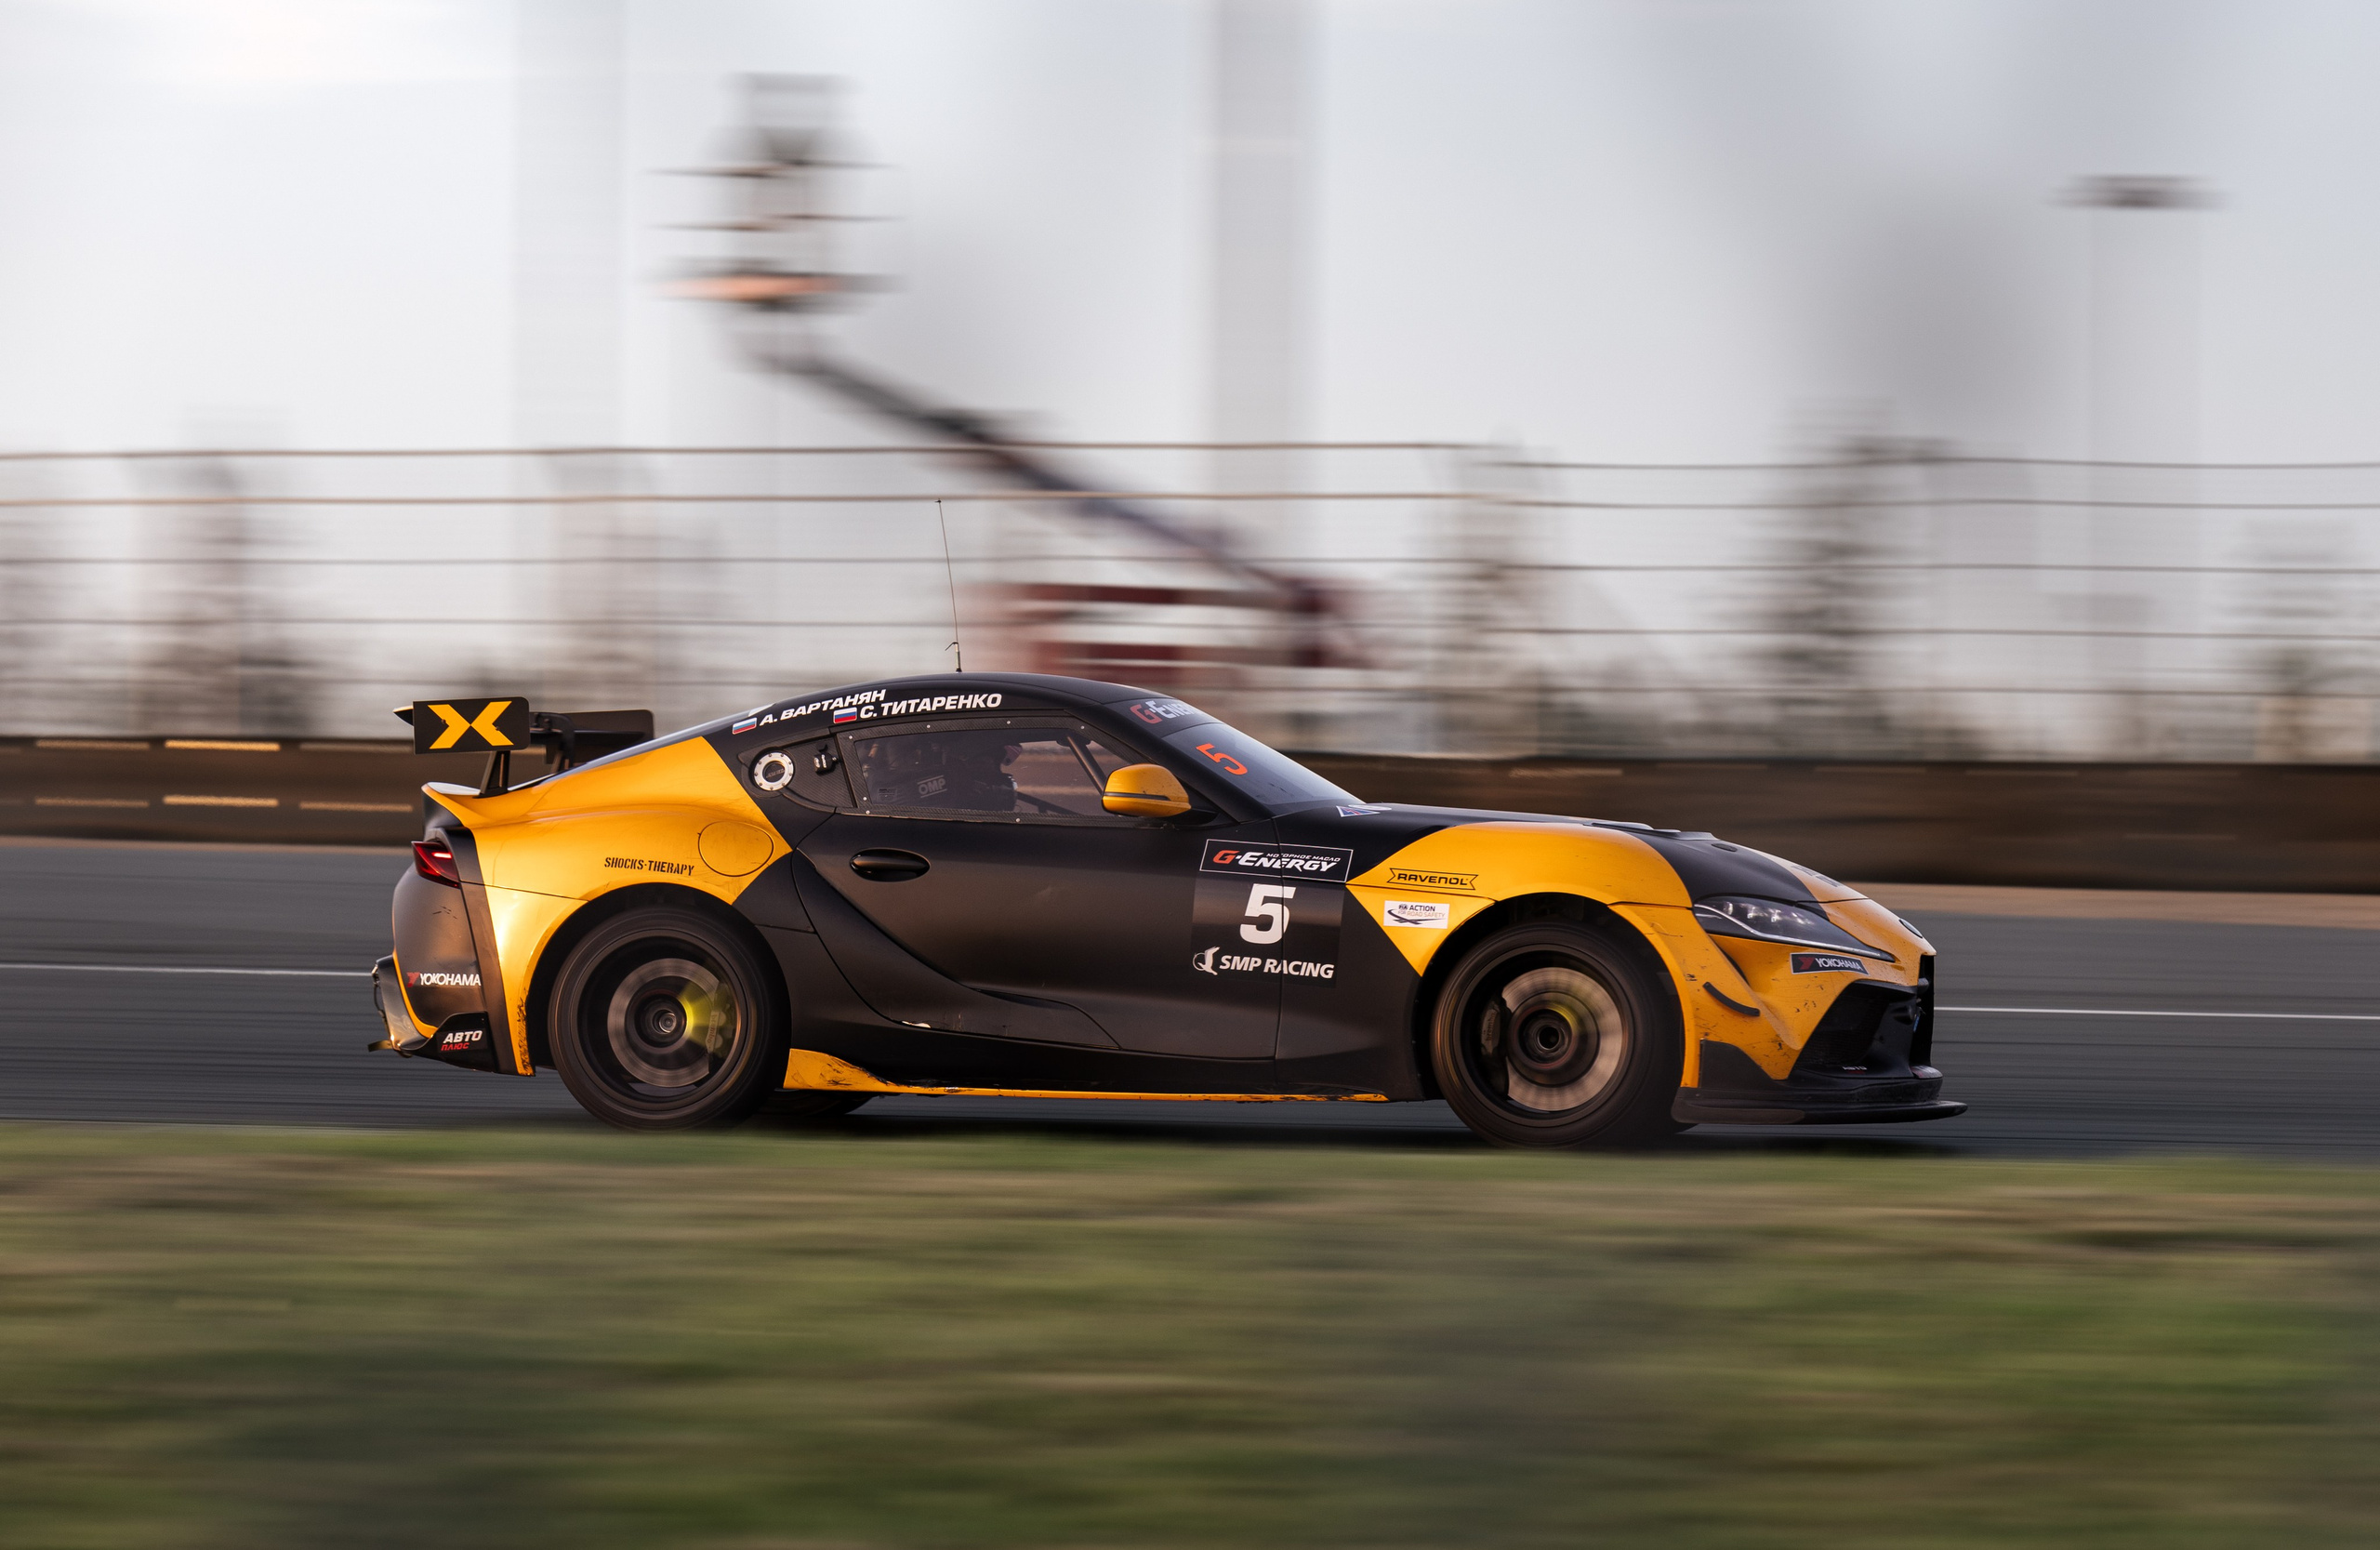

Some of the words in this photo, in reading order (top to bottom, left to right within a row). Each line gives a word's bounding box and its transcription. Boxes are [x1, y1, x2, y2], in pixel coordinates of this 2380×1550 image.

[759, 714, 777, 726] А.
[780, 689, 887, 720] ВАРТАНЯН
[859, 705, 878, 719] С.
[882, 693, 1002, 716] ТИТАРЕНКО
[1196, 742, 1248, 775] 5
[918, 777, 946, 795] OMP
[1397, 873, 1468, 885] RAVENOL
[1239, 883, 1296, 945] 5
[1219, 955, 1262, 972] SMP
[1263, 958, 1335, 979] RACING
[1815, 958, 1864, 972] YOKOHAMA
[419, 973, 481, 986] YOKOHAMA
[443, 1030, 483, 1043] АВТО
